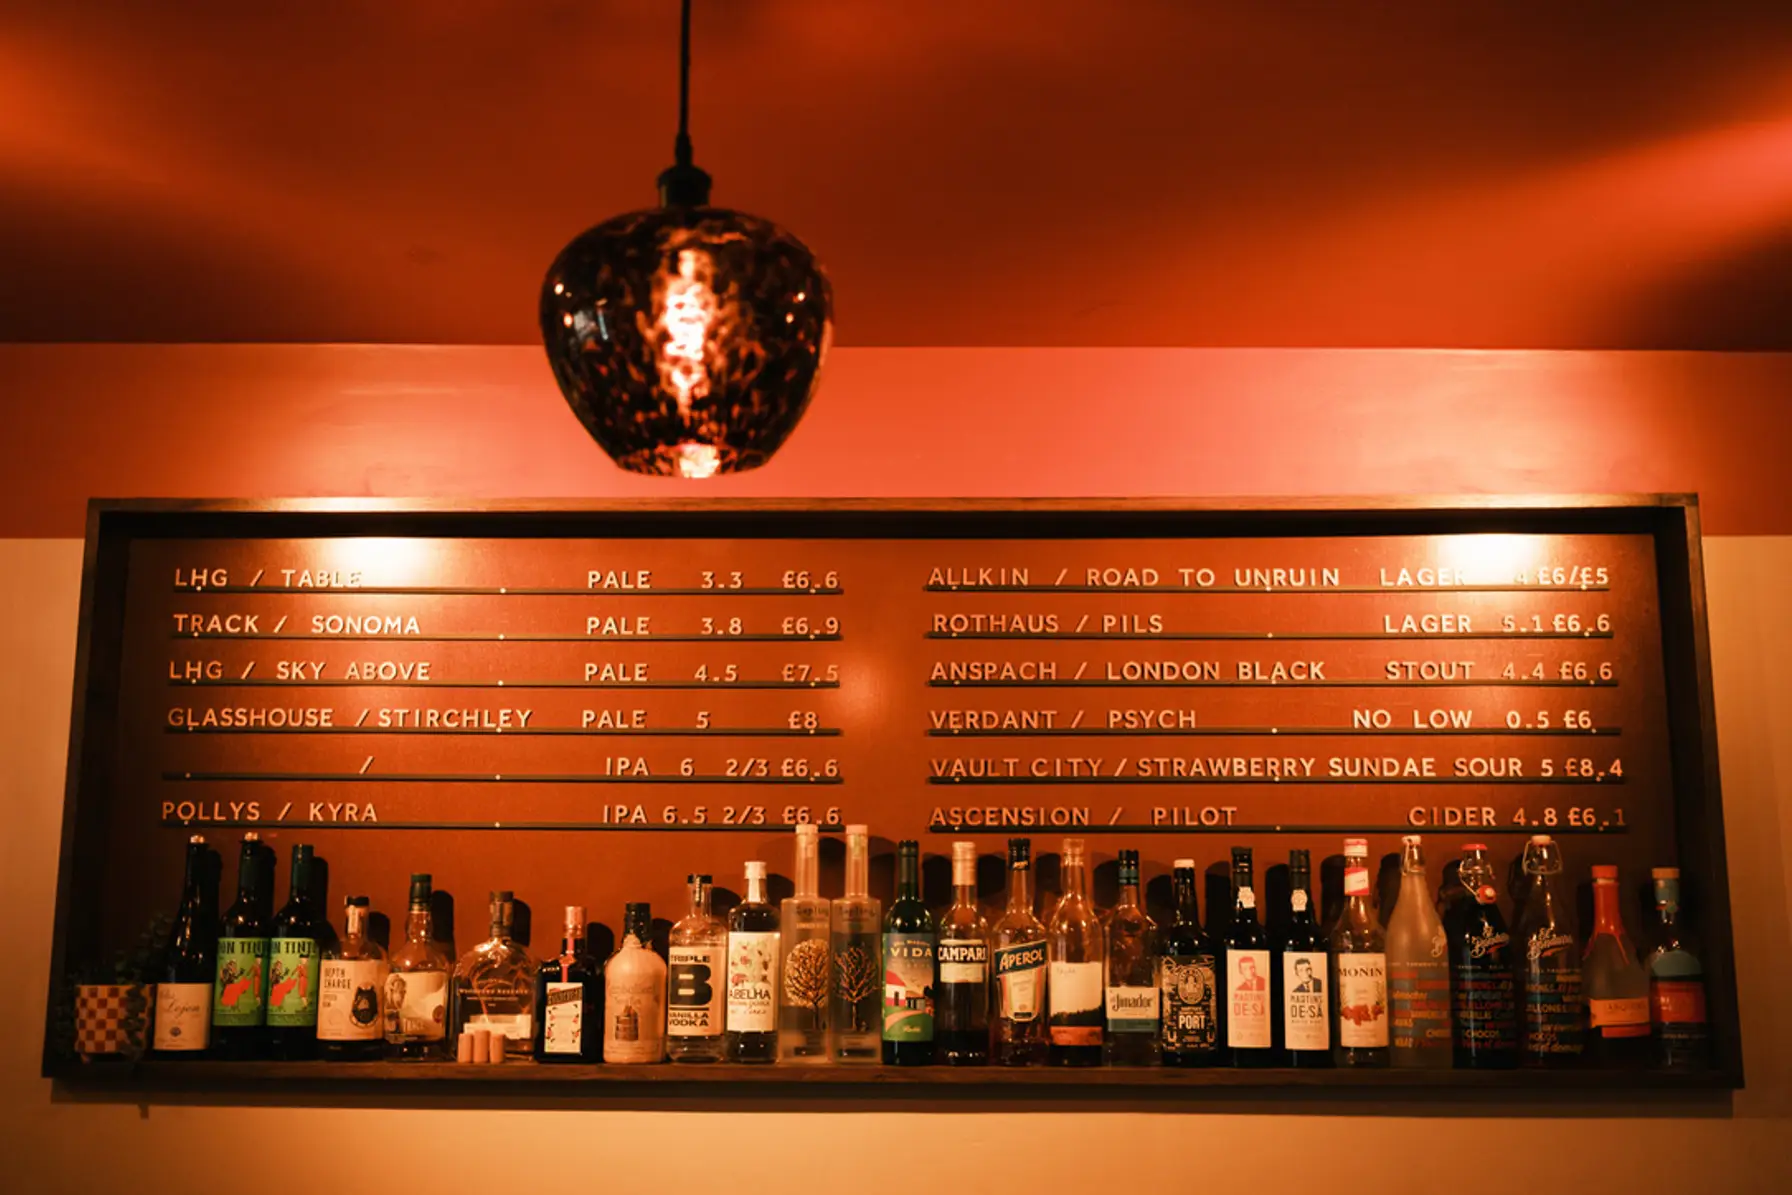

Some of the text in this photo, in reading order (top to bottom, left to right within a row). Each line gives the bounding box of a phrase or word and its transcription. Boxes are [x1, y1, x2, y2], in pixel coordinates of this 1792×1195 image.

[175, 568, 228, 587] LHG
[281, 569, 362, 588] TABLE
[587, 571, 651, 589] PALE
[701, 572, 742, 589] 3.3
[782, 572, 838, 589] £6.6
[928, 568, 1028, 586] ALLKIN
[1087, 568, 1159, 586] ROAD
[1178, 568, 1215, 586] TO
[1235, 567, 1340, 587] UNRUIN
[1537, 566, 1609, 586] £6/£5
[174, 614, 259, 633] TRACK
[311, 615, 420, 635] SONOMA
[586, 617, 650, 635] PALE
[701, 617, 742, 635] 3.8
[782, 617, 839, 635] £6.9
[933, 614, 1059, 633] ROTHAUS
[1103, 614, 1163, 633] PILS
[1384, 614, 1472, 633] LAGER
[1502, 614, 1543, 632] 5.1
[1553, 614, 1609, 632] £6.6
[169, 661, 223, 680] LHG
[276, 661, 326, 680] SKY
[345, 661, 430, 680] ABOVE
[585, 663, 648, 681] PALE
[695, 664, 738, 682] 4.5
[782, 664, 838, 682] £7.5
[931, 661, 1057, 680] ANSPACH
[1107, 661, 1220, 680] LONDON
[1237, 661, 1325, 680] BLACK
[1385, 661, 1476, 680] STOUT
[1502, 662, 1544, 680] 4.4
[168, 708, 333, 727] GLASSHOUSE
[582, 710, 646, 728] PALE
[696, 711, 710, 729] 5
[788, 711, 818, 729] £8
[930, 710, 1057, 729] VERDANT
[1109, 710, 1196, 729] PSYCH
[1353, 709, 1391, 728] NO
[1413, 709, 1473, 728] LOW
[1506, 710, 1549, 729] 0.5
[605, 757, 649, 776] IPA
[680, 758, 694, 776] 6
[726, 758, 768, 777] 2/3
[781, 759, 838, 777] £6.6
[931, 758, 1019, 777] VAULT
[1031, 758, 1102, 777] CITY
[1328, 757, 1436, 777] SUNDAE
[1454, 757, 1523, 777] SOUR
[1541, 758, 1553, 777] 5
[1565, 758, 1623, 777] £8.4
[162, 801, 260, 821] POLLYS
[309, 803, 377, 821] KYRA
[603, 805, 647, 824] IPA
[663, 806, 707, 824] 6.5
[722, 806, 765, 825] 2/3
[782, 806, 840, 825] £6.6
[930, 806, 1089, 825] ASCENSION
[1154, 806, 1237, 825] PILOT
[1409, 806, 1496, 826] CIDER
[1513, 807, 1557, 826] 4.8
[1568, 807, 1626, 826] £6.1
[890, 947, 932, 957] VIDA
[938, 947, 986, 961] CAMPARI
[999, 949, 1043, 971] APEROL
[1339, 967, 1383, 978] MONIN
[670, 964, 713, 1005] B
[1178, 1015, 1205, 1030] PORT
